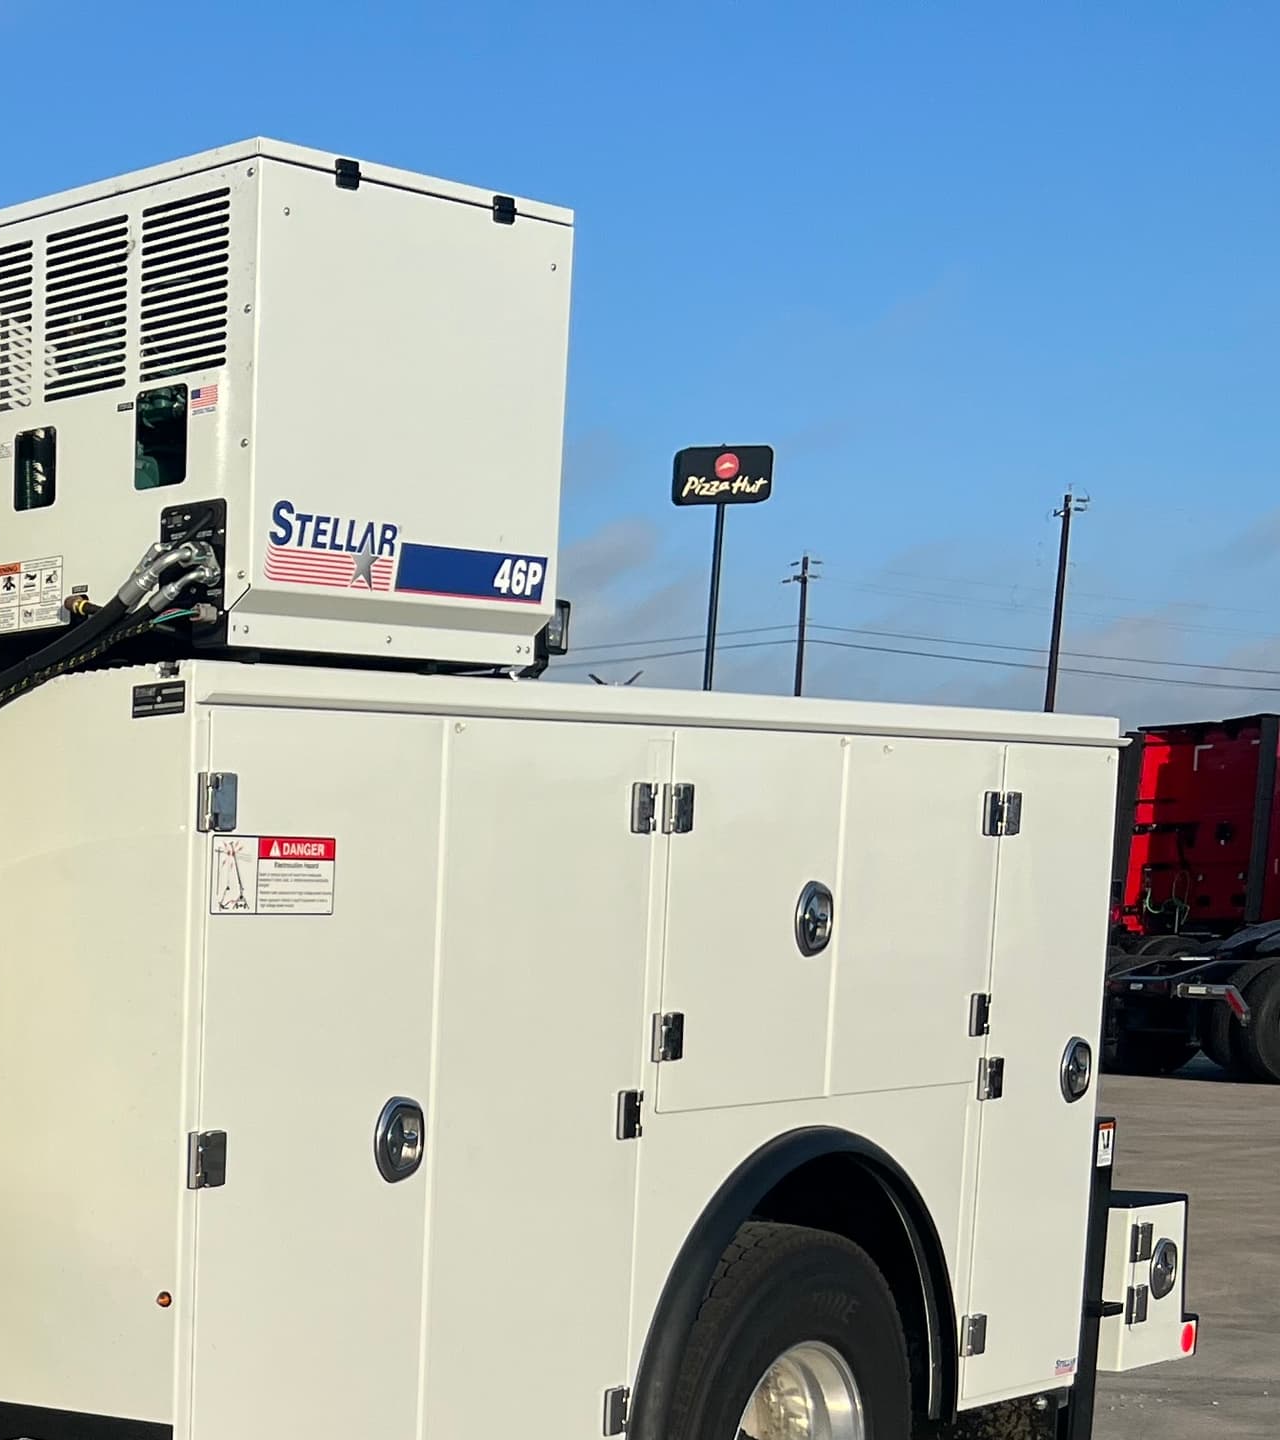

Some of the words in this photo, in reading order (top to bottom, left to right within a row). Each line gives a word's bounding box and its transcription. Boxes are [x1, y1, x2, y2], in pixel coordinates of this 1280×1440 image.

[682, 475, 730, 497] Pizza
[732, 475, 768, 494] Hut
[269, 500, 398, 556] STELLAR
[493, 559, 543, 597] 46P
[282, 842, 325, 856] DANGER
